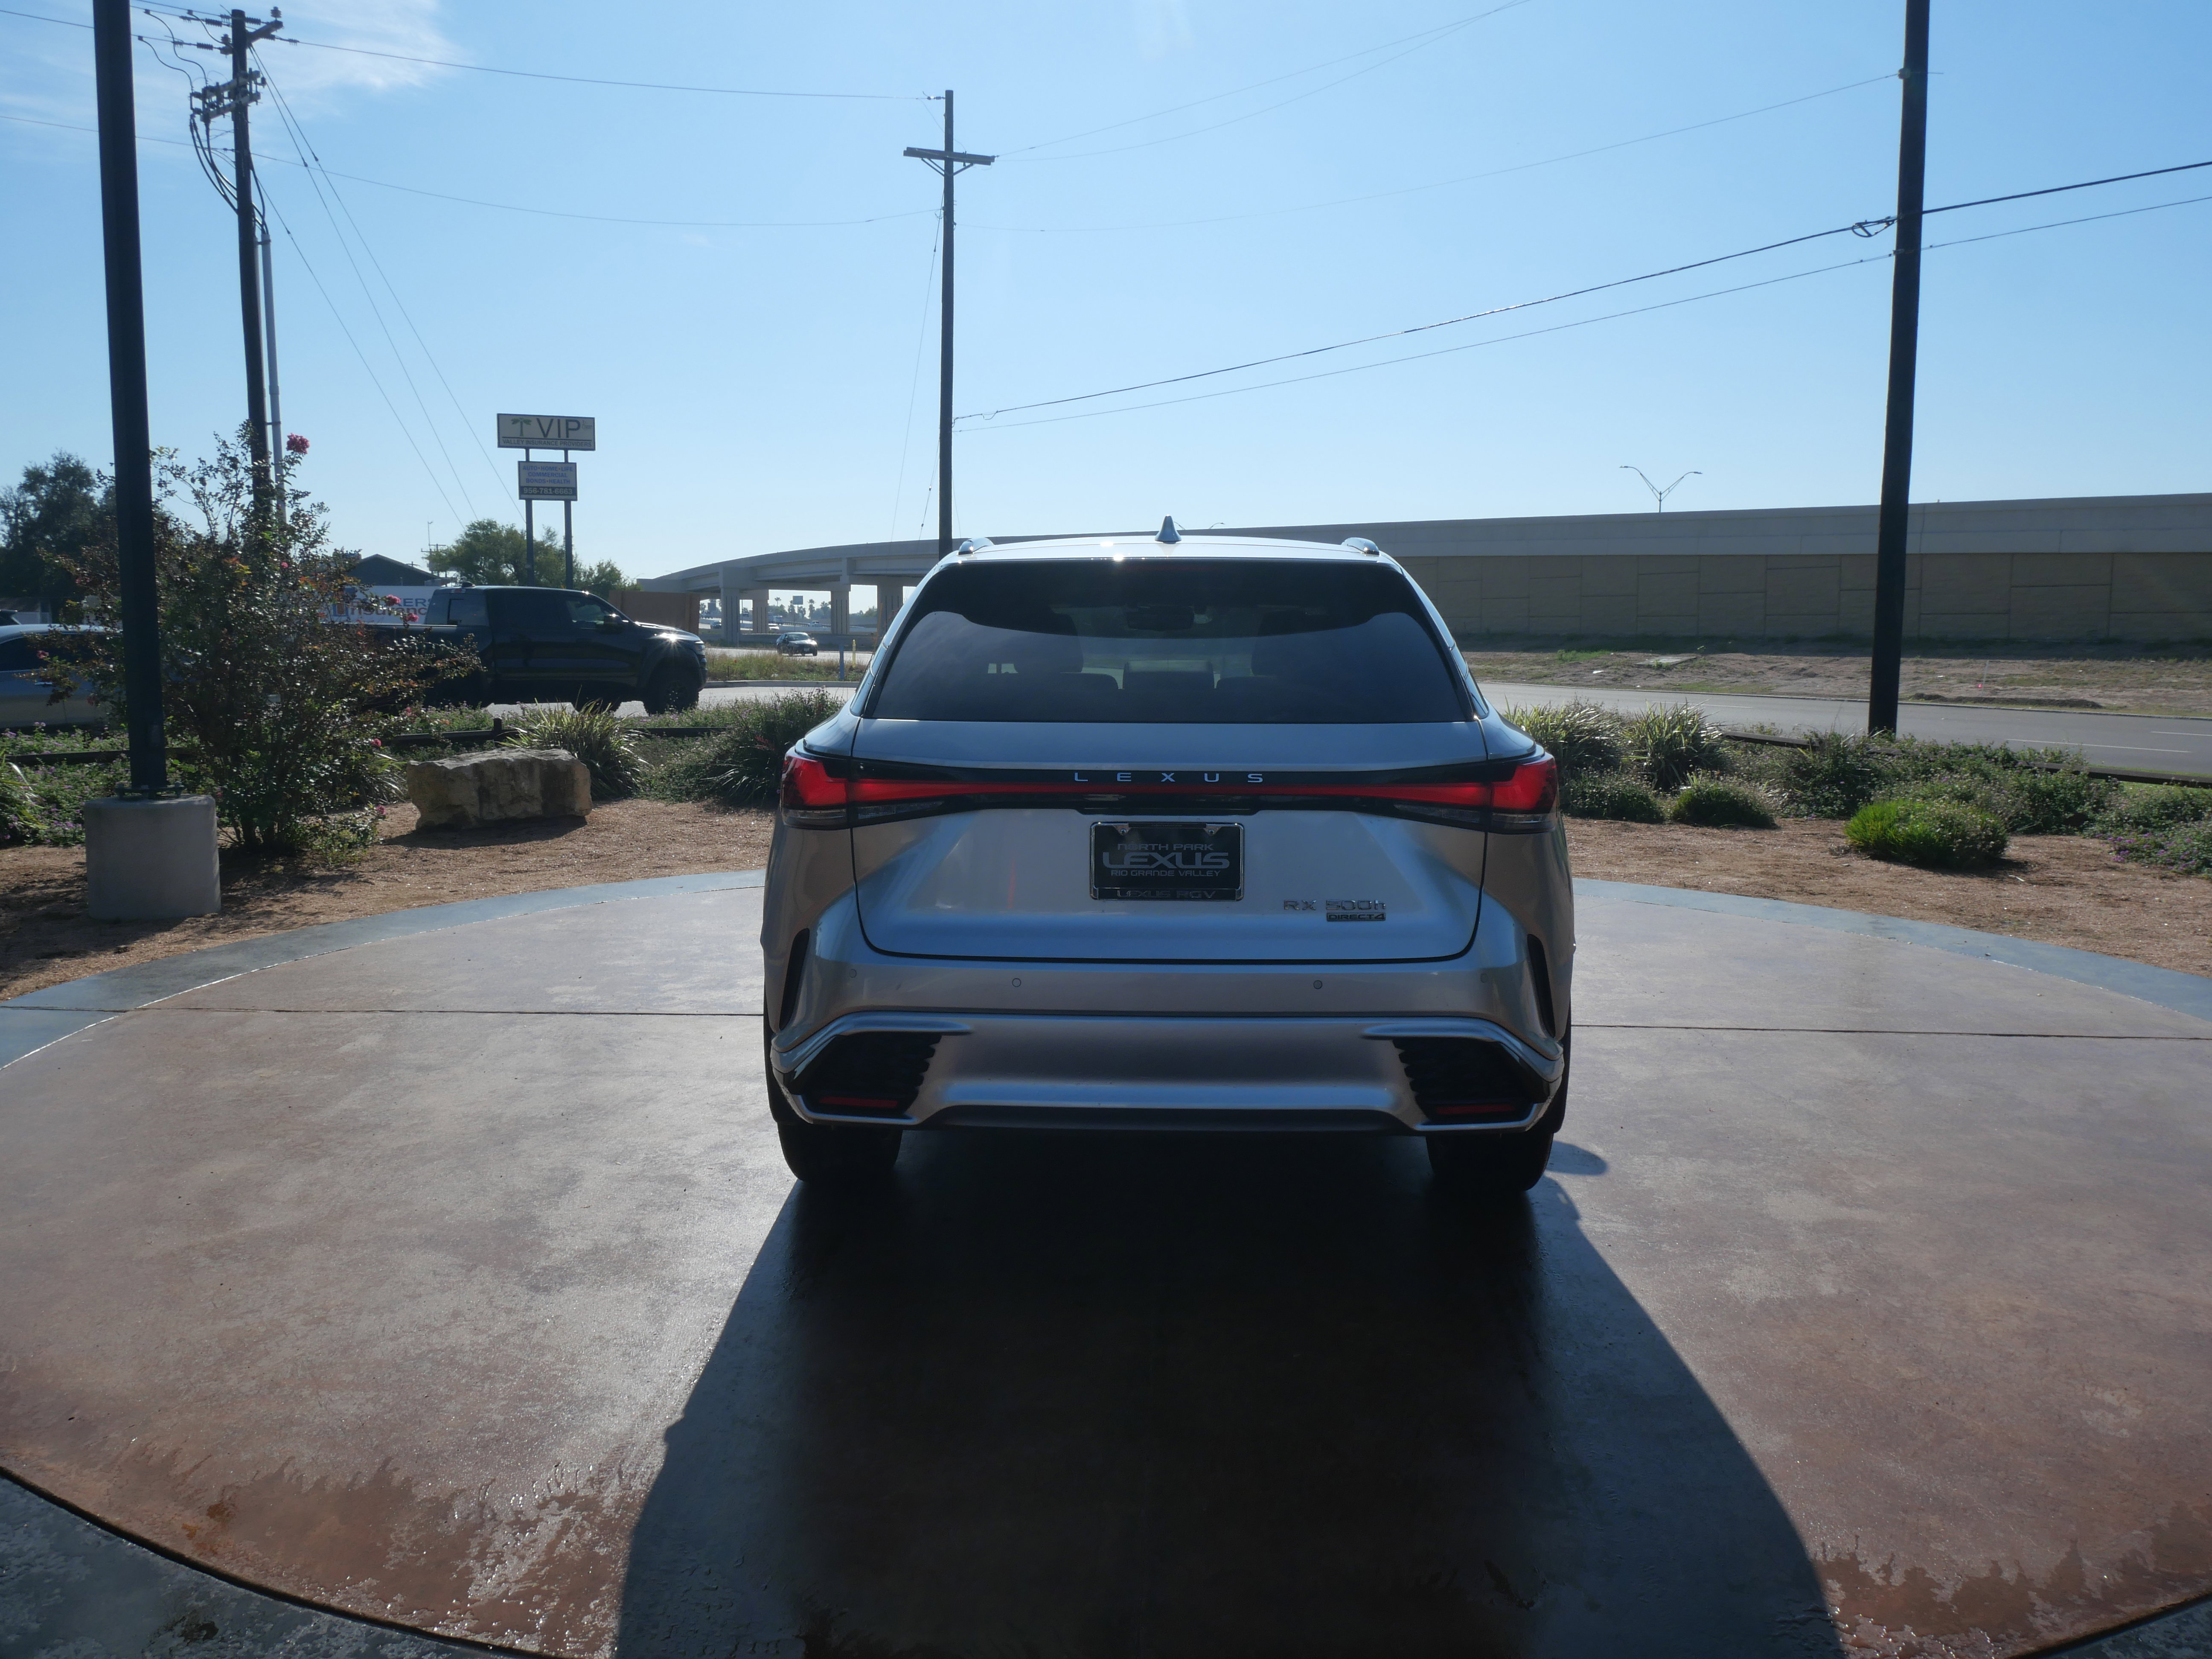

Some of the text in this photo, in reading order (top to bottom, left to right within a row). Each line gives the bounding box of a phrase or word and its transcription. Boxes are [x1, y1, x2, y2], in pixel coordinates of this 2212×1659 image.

[536, 418, 581, 438] VIP
[1074, 772, 1263, 783] LEXUS
[1103, 852, 1230, 869] LEXUS
[1284, 899, 1386, 910] RX 500h
